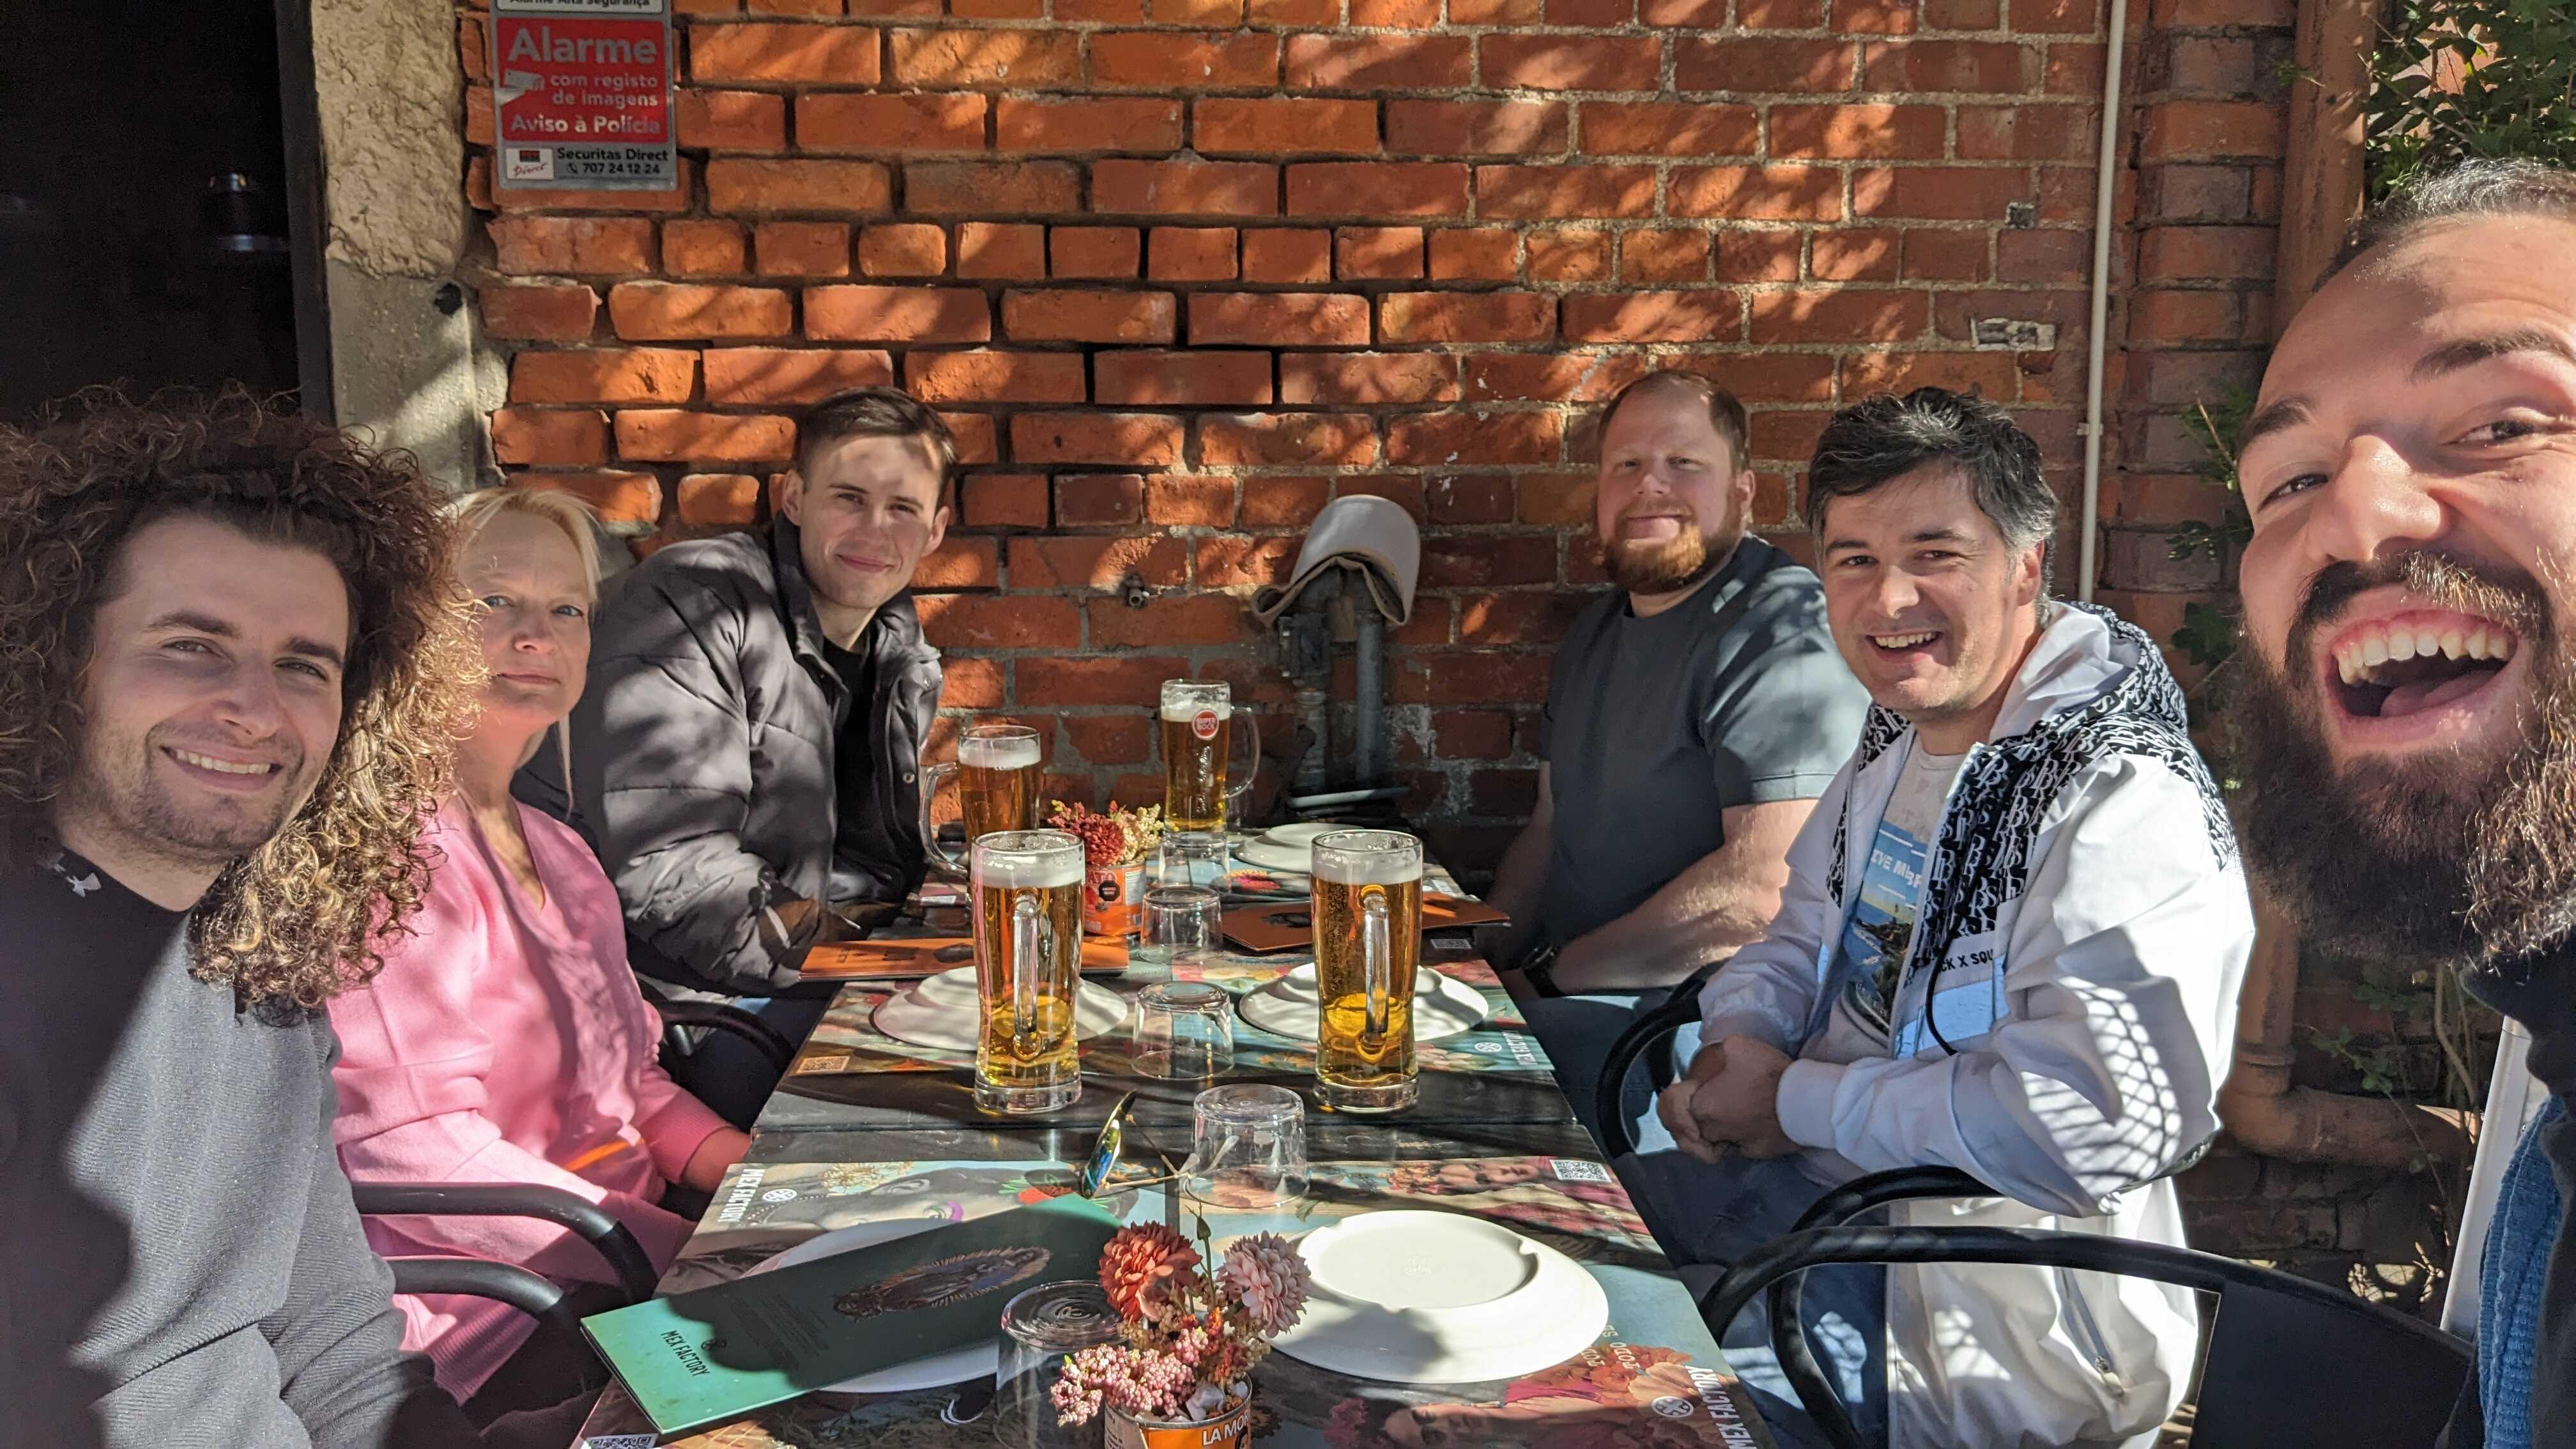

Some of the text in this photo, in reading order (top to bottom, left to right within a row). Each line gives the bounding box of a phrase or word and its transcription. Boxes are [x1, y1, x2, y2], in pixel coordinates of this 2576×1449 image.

[507, 26, 657, 63] Alarme
[549, 73, 657, 90] com registo
[551, 91, 658, 109] de imagens
[510, 114, 661, 134] Aviso à Polícia
[557, 148, 668, 160] Securitas Direct
[583, 162, 661, 174] 707 24 12 24
[1870, 848, 1893, 871] IVE
[1958, 954, 1969, 968] X
[1970, 949, 1994, 965] SQU
[717, 1169, 765, 1223] MEX FACTORY
[660, 1330, 710, 1376] MEX FACTORY
[1609, 1342, 1641, 1370] TODO
[1685, 1365, 1758, 1449] MEX FACTORY
[1202, 1427, 1222, 1446] LA
